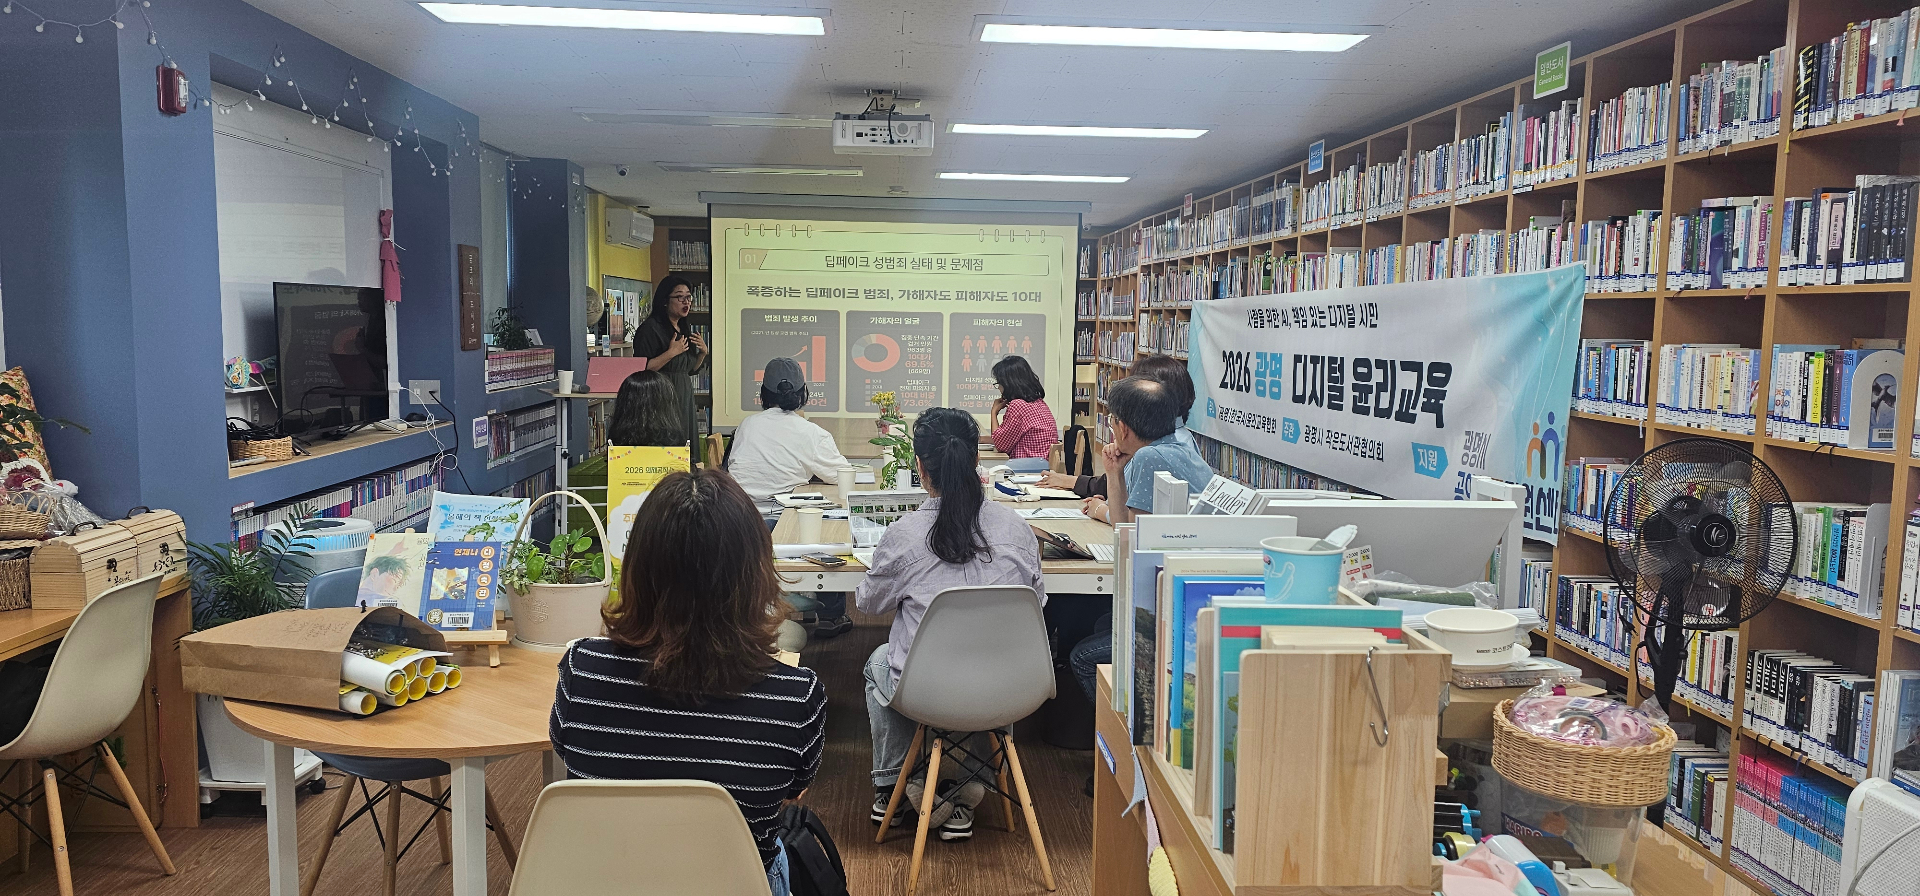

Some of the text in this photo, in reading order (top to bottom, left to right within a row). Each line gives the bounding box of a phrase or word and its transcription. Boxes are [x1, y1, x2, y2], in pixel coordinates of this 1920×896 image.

[744, 254, 756, 264] 01
[825, 255, 984, 272] 딥페이크 성범죄 실태 및 문제점
[747, 286, 1042, 302] 폭증하는 딥페이크 범죄, 가해자도 피해자도 10대
[764, 314, 817, 323] 범죄 발생 추이
[870, 317, 920, 325] 가해자의 얼굴
[1246, 302, 1379, 330] 사람을 위한 AI, 책임 있는 디지털 시민
[1006, 319, 1023, 327] 현실
[1219, 350, 1453, 429] 2026 광명 디지털 윤리교육
[1283, 420, 1385, 463] 주관 광명시 작은도서관협의회
[1417, 430, 1492, 472] 지원 광명시
[625, 466, 644, 474] 2026
[454, 548, 479, 557] 언제나
